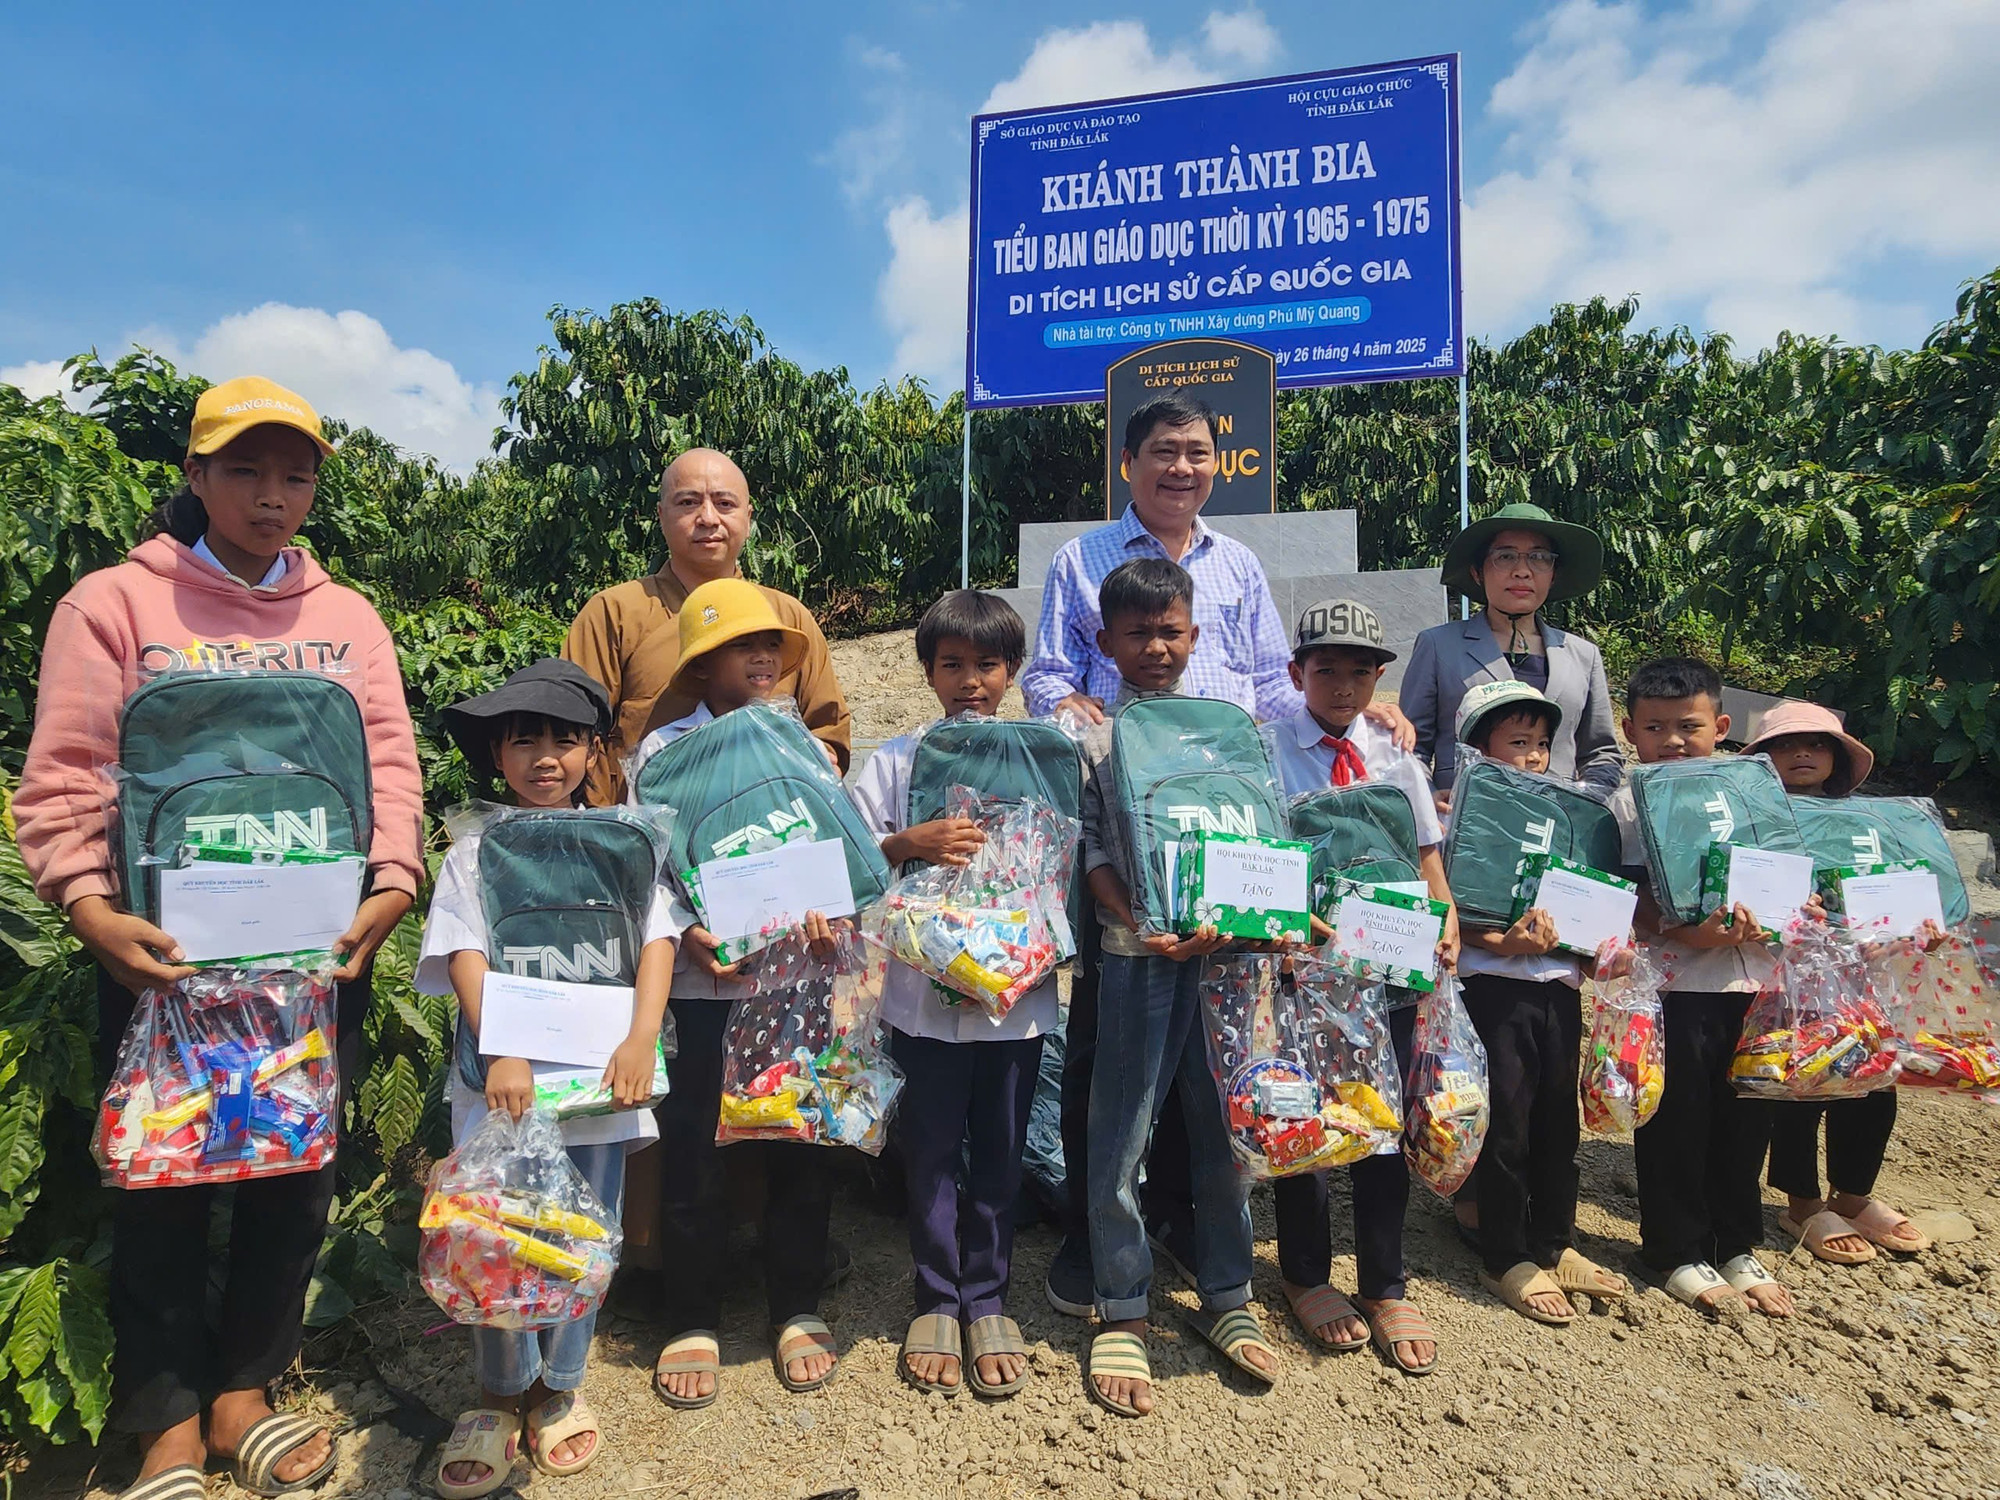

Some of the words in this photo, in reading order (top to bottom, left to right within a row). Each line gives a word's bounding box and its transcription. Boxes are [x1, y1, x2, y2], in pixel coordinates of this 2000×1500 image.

[1288, 90, 1310, 104] HỘI
[1314, 87, 1340, 101] CỰU
[1342, 82, 1374, 97] GIÁO
[1376, 77, 1413, 92] CHỨC
[1306, 102, 1336, 117] TỈNH
[1340, 98, 1365, 114] ĐẮK
[1369, 95, 1394, 110] LẮK
[1000, 126, 1015, 139] SỞ
[1018, 121, 1045, 137] GIÁO
[1048, 120, 1070, 135] DỤC
[1073, 117, 1088, 130] VÀ
[1090, 114, 1115, 129] ĐÀO
[1117, 113, 1141, 126] TẠO
[1030, 136, 1058, 150] TỈNH
[1060, 133, 1083, 148] ĐẮK
[1086, 130, 1109, 144] LẮK
[1042, 160, 1164, 213] KHÁNH
[1175, 144, 1300, 198] THÀNH
[1312, 141, 1376, 184] BIA
[994, 223, 1038, 274] TIỂU
[1044, 231, 1087, 270] BAN
[1094, 219, 1143, 265] GIÁO
[1150, 220, 1194, 266] DỤC
[1201, 206, 1250, 254] THỜI
[1257, 203, 1286, 249] KỲ
[1294, 204, 1349, 245] 1965
[1356, 219, 1365, 228] -
[1373, 196, 1430, 238] 1975
[1009, 294, 1032, 316] DI
[1040, 285, 1096, 312] TÍCH
[1104, 282, 1160, 312] LỊCH
[1168, 272, 1200, 300] SỬ
[1207, 264, 1262, 296] CẤP
[1270, 256, 1353, 292] QUỐC
[1361, 259, 1412, 283] GIA
[1053, 326, 1076, 342] Nhà
[1079, 324, 1093, 340] tài
[1097, 323, 1116, 339] trợ:
[1120, 321, 1151, 338] Công
[1154, 320, 1166, 336] ty
[1169, 316, 1204, 333] TNHH
[1208, 313, 1230, 331] Xây
[1234, 312, 1265, 329] dựng
[1269, 308, 1293, 324] Phú
[1296, 306, 1315, 324] Mỹ
[1318, 304, 1360, 321] Quang
[1276, 352, 1290, 366] ày
[1294, 348, 1309, 362] 26
[1312, 344, 1349, 362] tháng
[1352, 343, 1360, 356] 4
[1364, 341, 1391, 356] năm
[1395, 337, 1427, 354] 2025
[1139, 365, 1153, 375] DI
[1156, 361, 1186, 373] TÍCH
[1190, 359, 1219, 371] LỊCH
[1223, 355, 1241, 368] SỬ
[1144, 374, 1169, 388] CẤP
[1173, 372, 1208, 387] QUỐC
[1212, 372, 1234, 382] GIA
[1216, 849, 1231, 859] HỘI
[1360, 909, 1375, 919] HỘI
